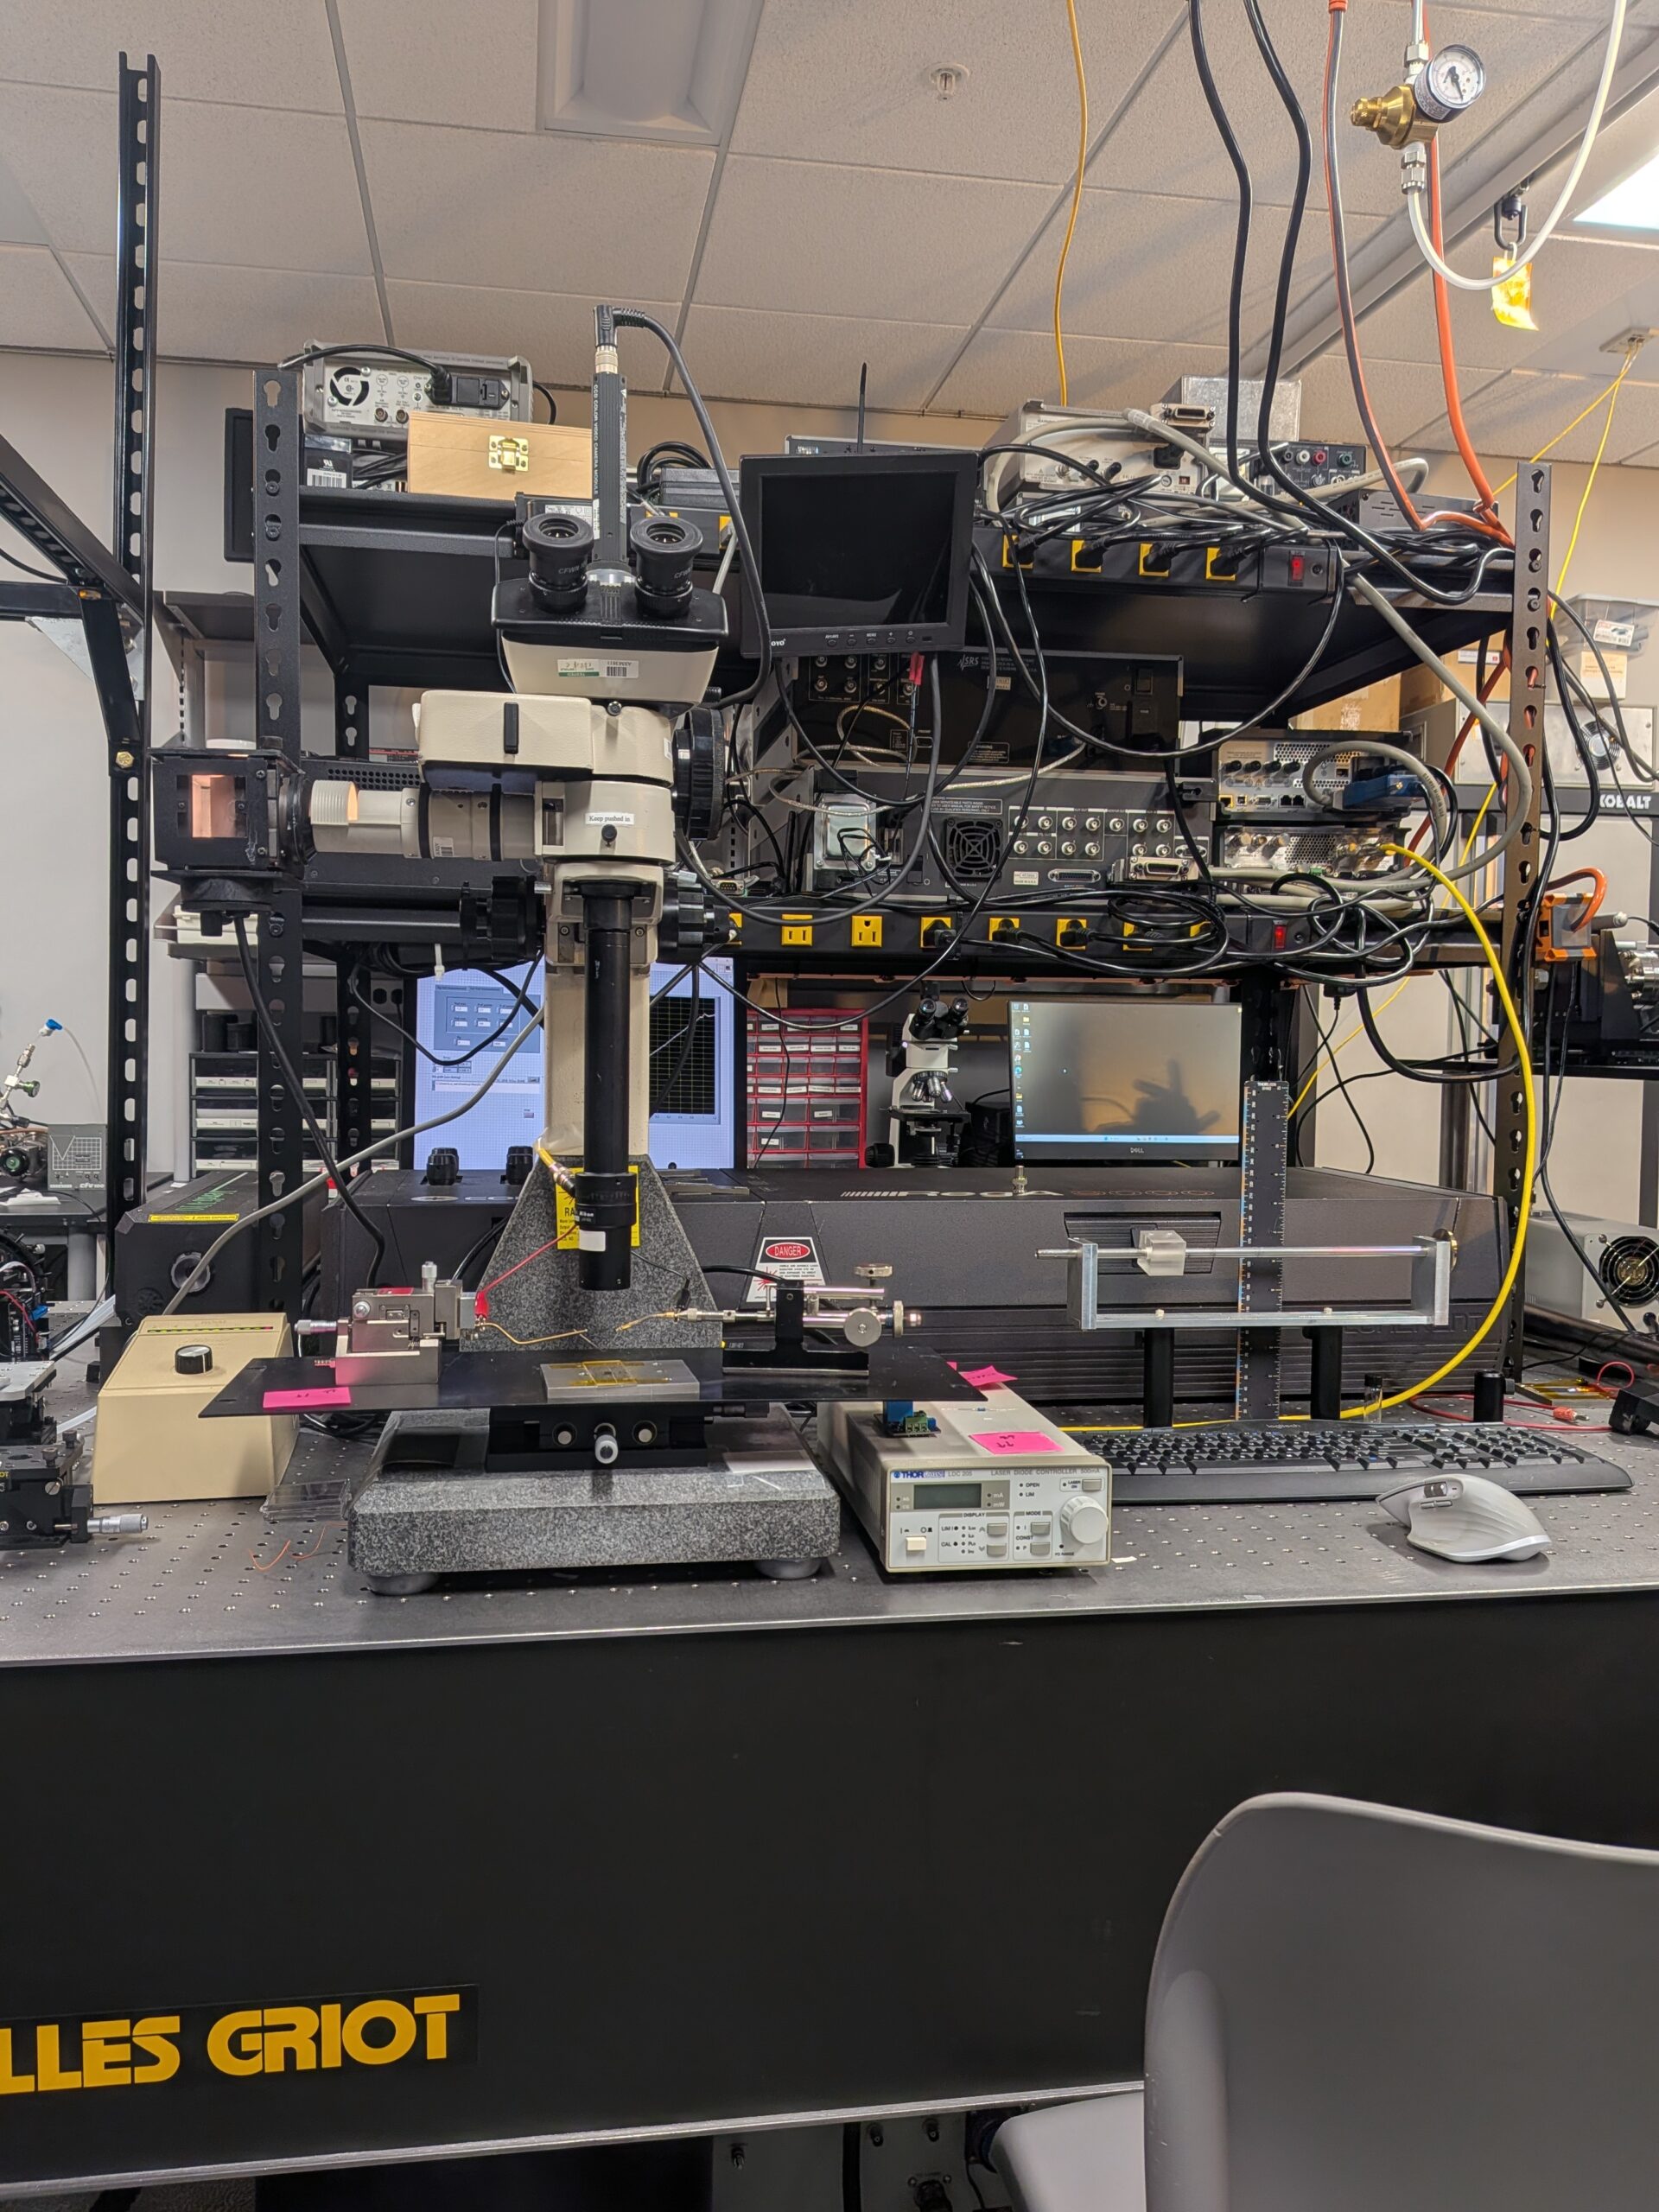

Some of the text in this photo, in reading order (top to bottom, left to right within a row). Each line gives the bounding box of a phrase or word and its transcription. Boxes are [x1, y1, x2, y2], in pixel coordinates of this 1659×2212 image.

[965, 656, 979, 665] SRS
[774, 1246, 802, 1256] DANGER
[0, 1993, 461, 2094] LLES GRIOT
